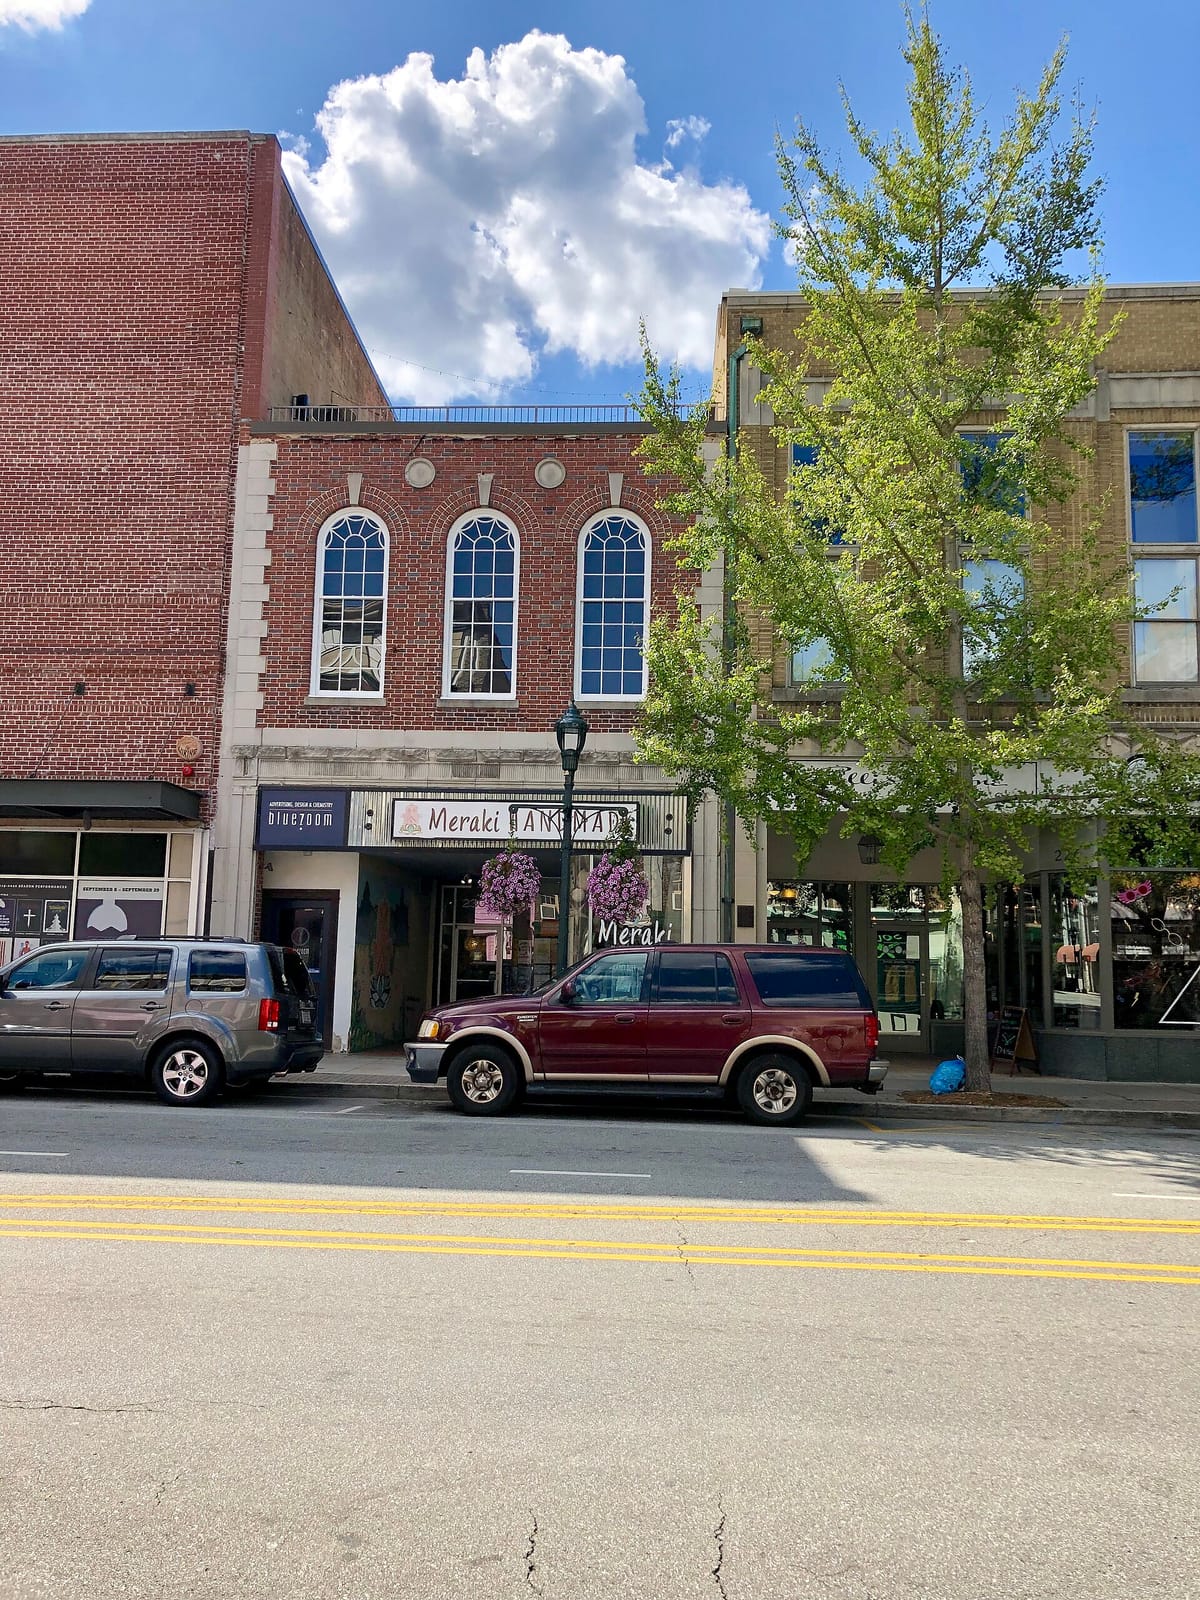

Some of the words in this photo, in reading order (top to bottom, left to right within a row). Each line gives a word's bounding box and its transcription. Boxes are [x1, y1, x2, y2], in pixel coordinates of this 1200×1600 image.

[268, 811, 333, 831] bluezoom
[428, 807, 501, 833] Meraki
[598, 919, 673, 945] Meraki
